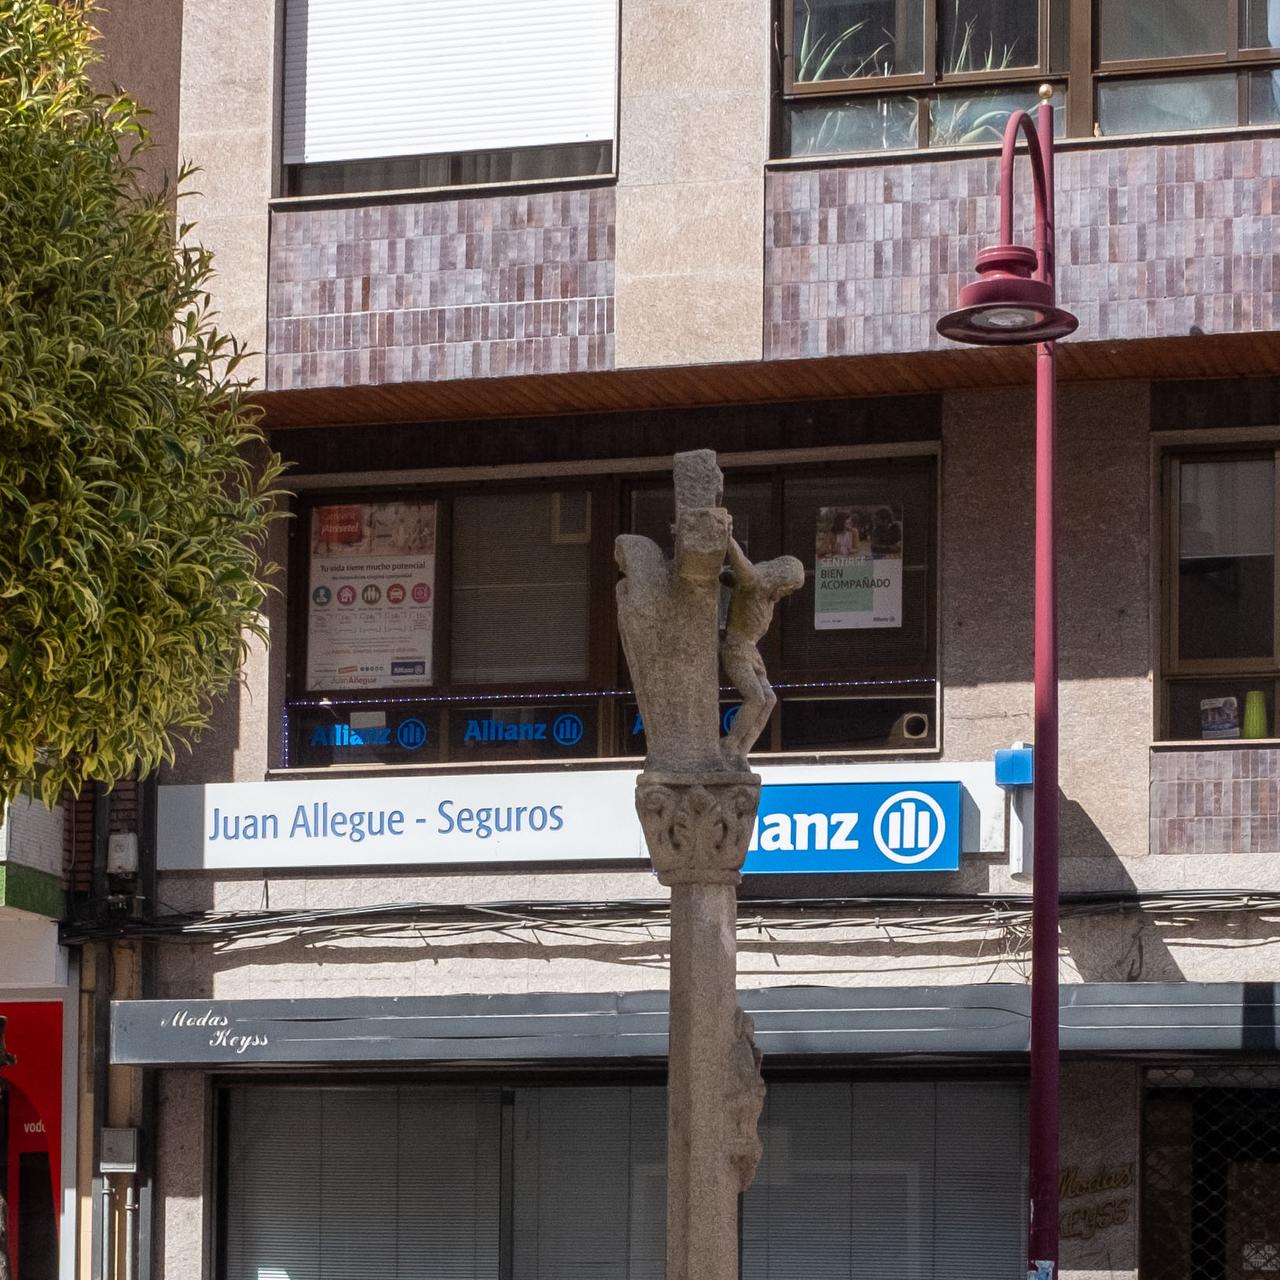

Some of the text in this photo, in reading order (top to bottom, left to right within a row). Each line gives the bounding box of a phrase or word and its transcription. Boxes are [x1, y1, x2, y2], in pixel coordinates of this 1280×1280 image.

[320, 561, 426, 573] Tu vida tiene mucho potencial
[821, 569, 844, 579] BIEN
[821, 577, 891, 590] ACOMPAÑADO
[311, 723, 391, 746] Allianz
[463, 719, 547, 742] Allianz
[209, 808, 279, 841] Juan
[289, 802, 405, 842] Allegue
[437, 800, 564, 839] Seguros
[161, 1007, 229, 1027] Modas
